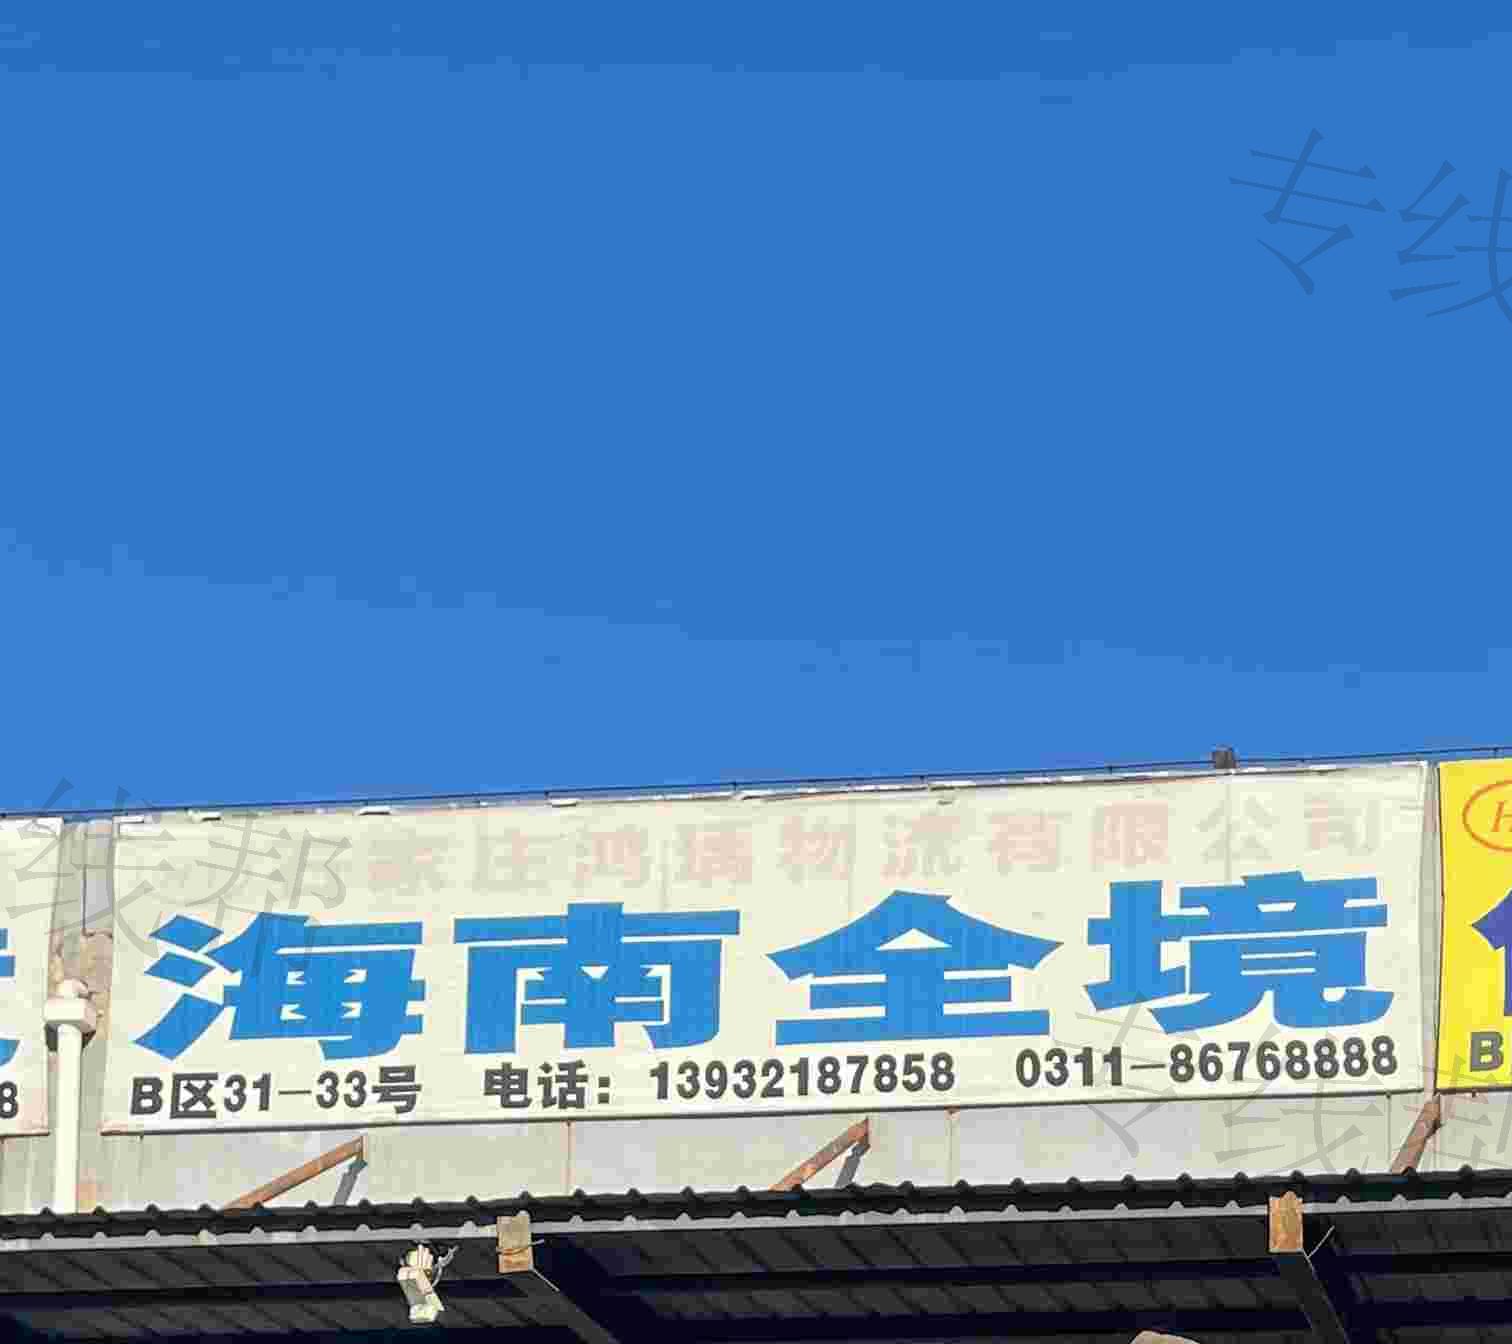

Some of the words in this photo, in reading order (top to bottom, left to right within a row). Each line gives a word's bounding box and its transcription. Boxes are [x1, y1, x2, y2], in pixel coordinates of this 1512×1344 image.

[365, 794, 1384, 895] 家庄鸿瑀物流有限公司
[134, 870, 1395, 1062] 海南全境
[484, 1059, 612, 1111] 电话：
[649, 1051, 956, 1100] 13932187858
[1016, 1035, 1397, 1090] 0311-86768888
